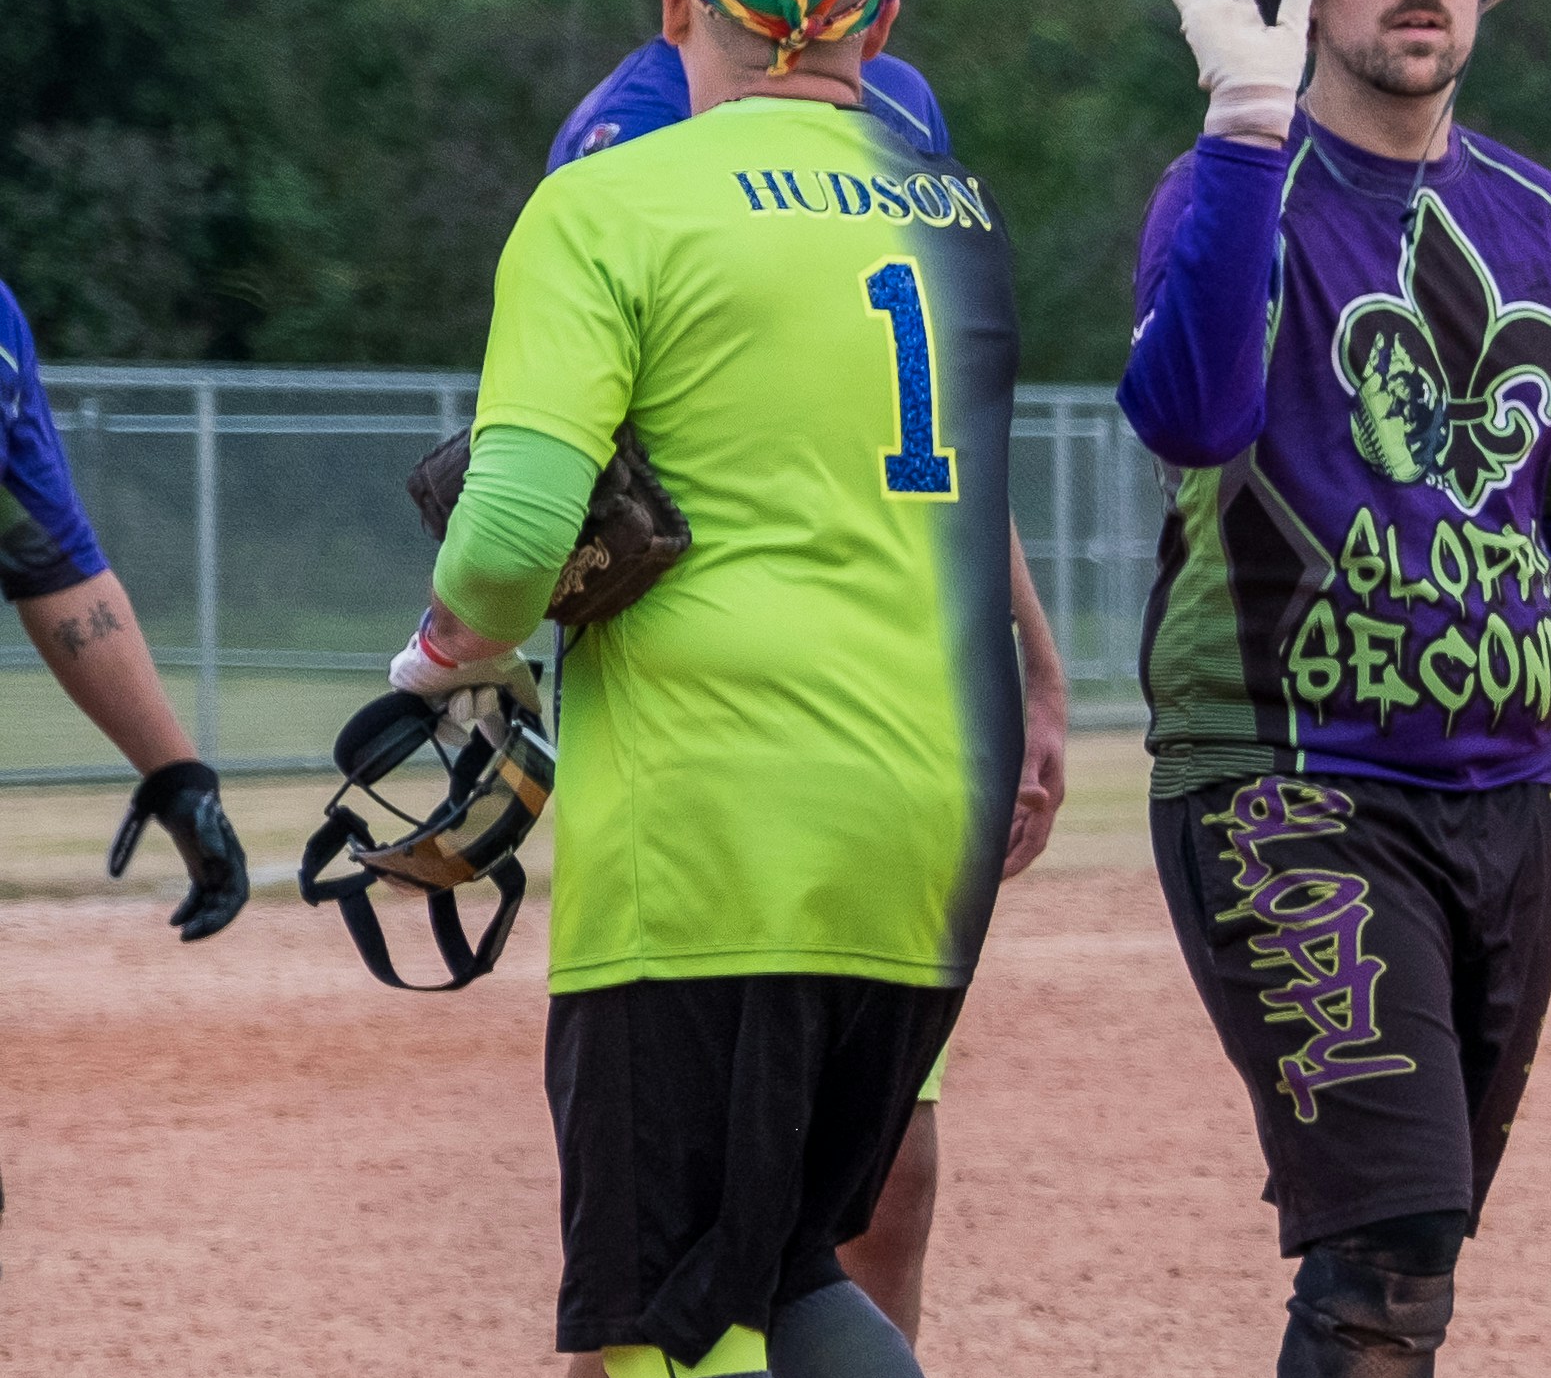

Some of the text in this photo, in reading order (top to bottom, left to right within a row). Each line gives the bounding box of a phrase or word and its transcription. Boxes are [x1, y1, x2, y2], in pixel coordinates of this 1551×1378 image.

[731, 168, 992, 232] HUDSON
[857, 254, 960, 503] 1
[1201, 776, 1416, 1123] SLOPPY
